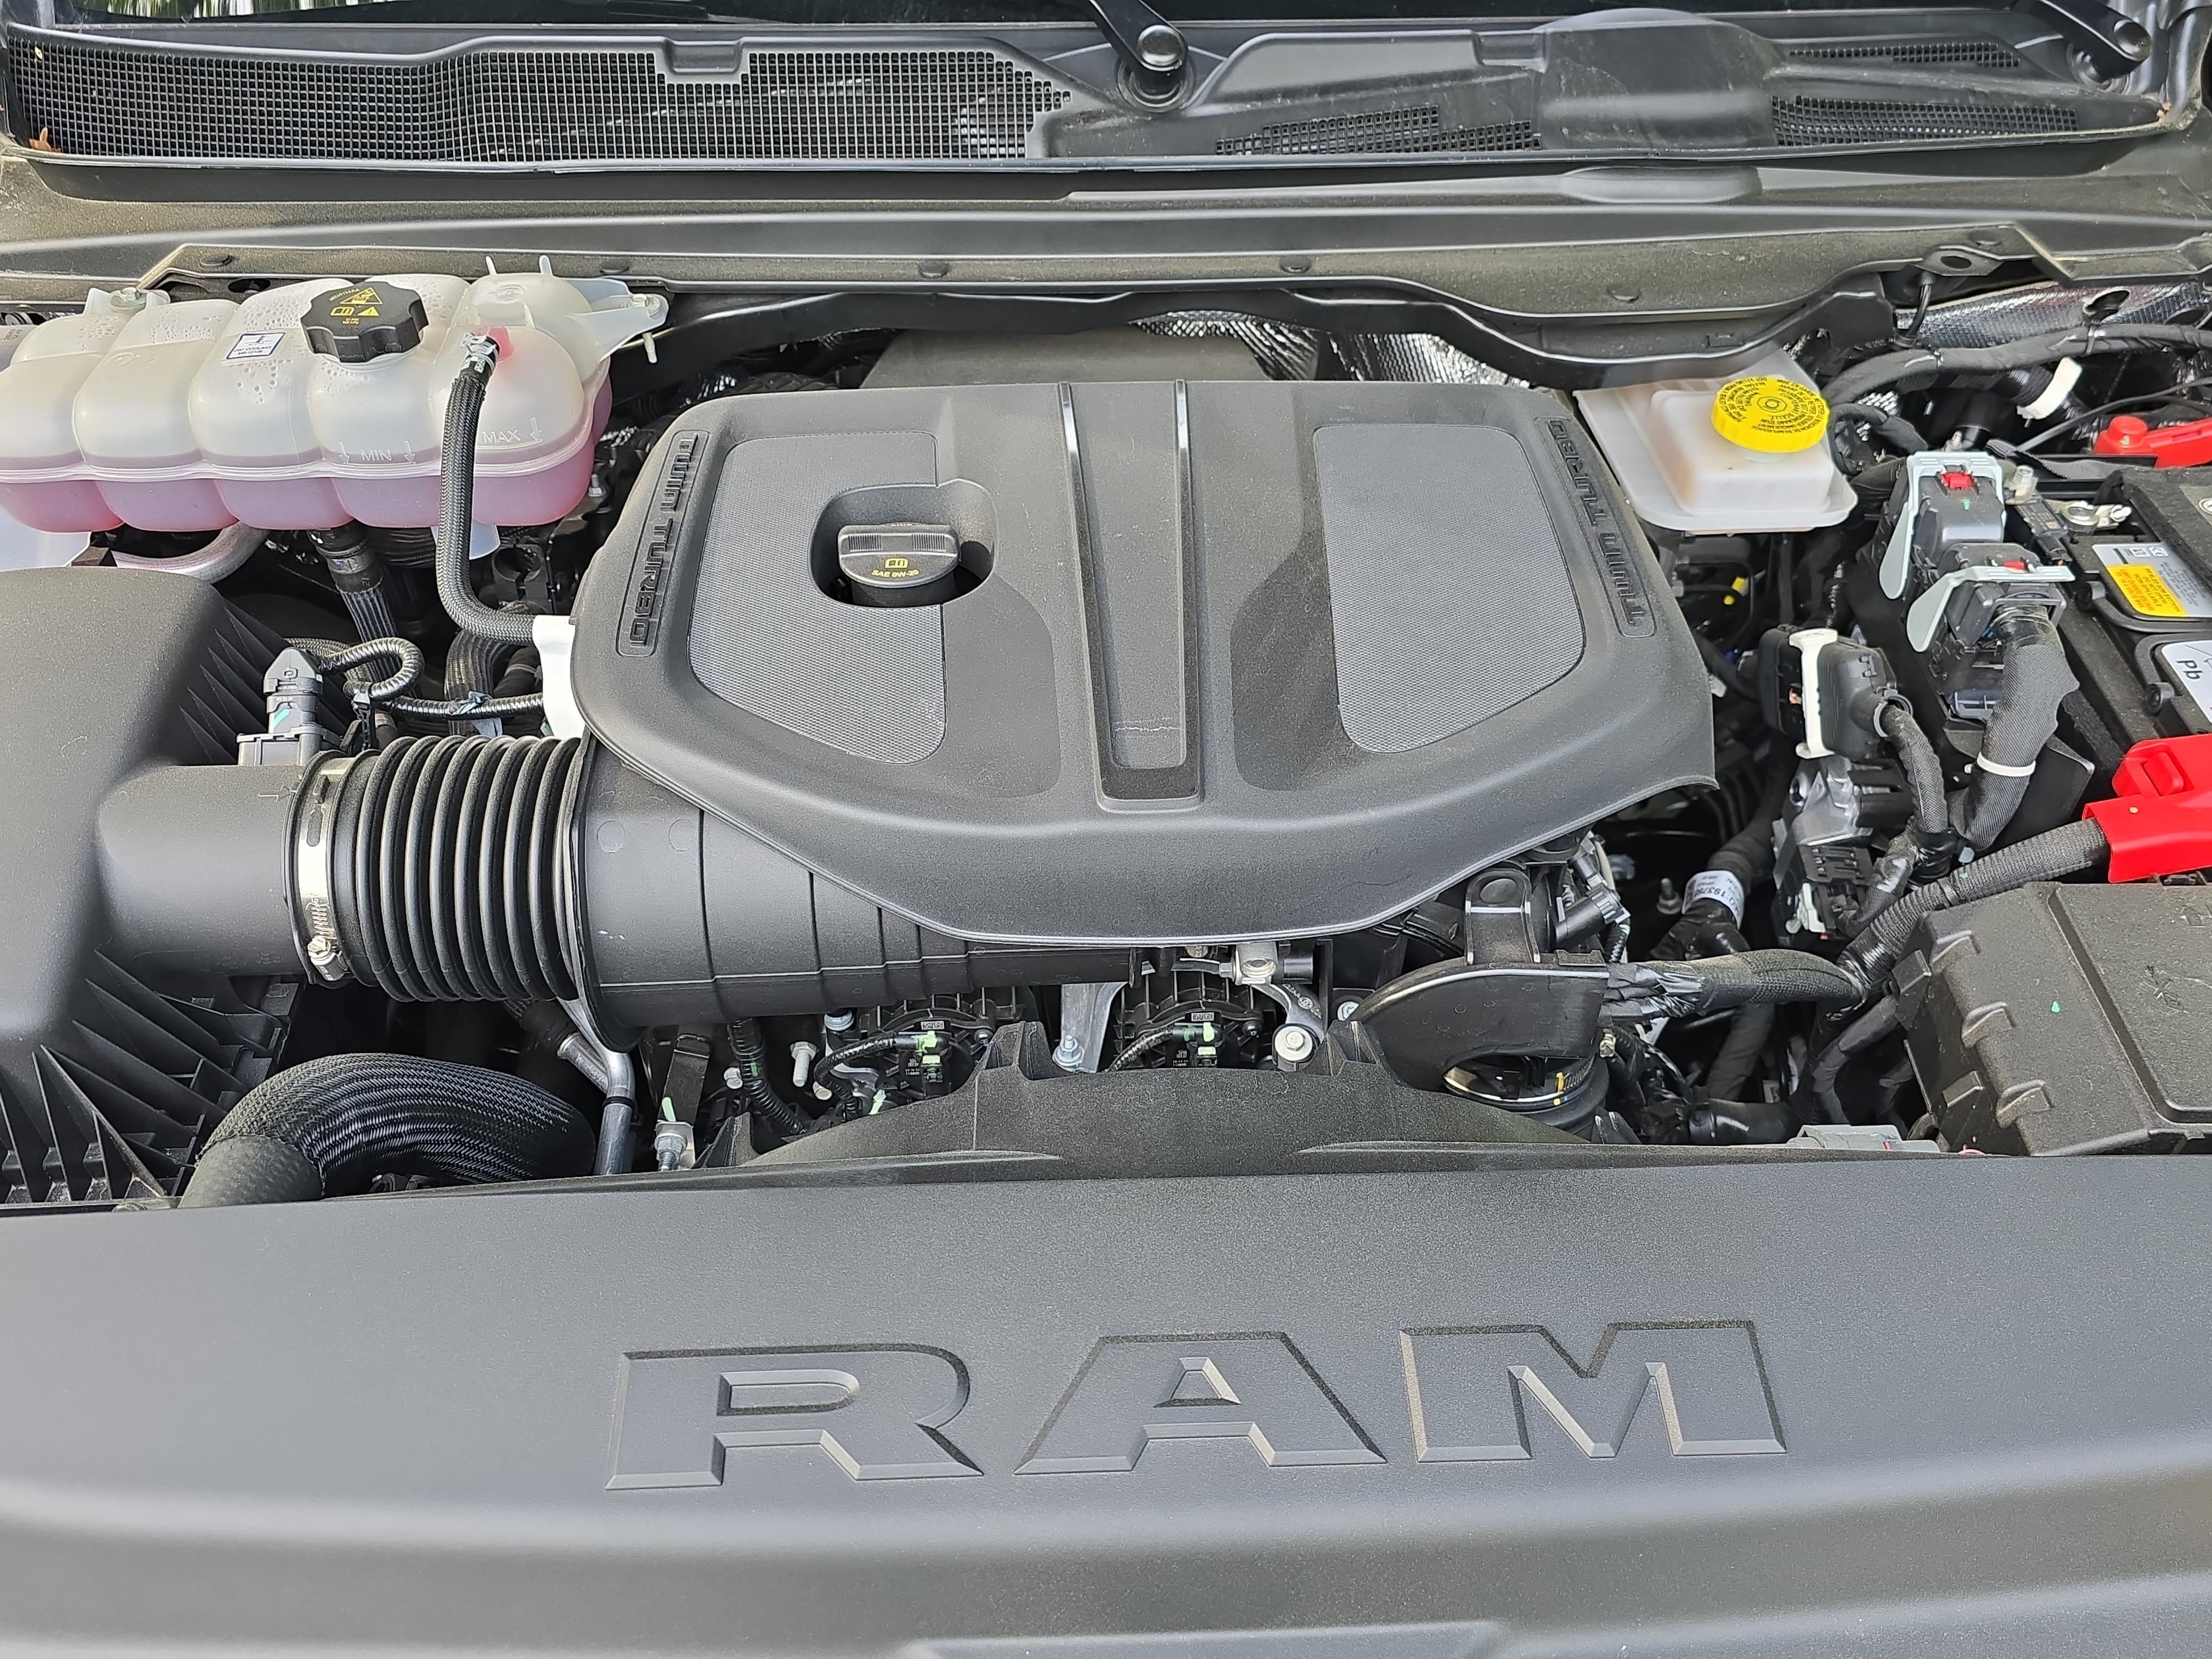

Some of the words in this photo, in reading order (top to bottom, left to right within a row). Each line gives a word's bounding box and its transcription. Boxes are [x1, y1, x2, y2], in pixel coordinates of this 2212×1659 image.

[361, 449, 392, 462] MIN
[481, 429, 522, 443] MAX
[659, 433, 699, 513] TWIN
[1547, 419, 1606, 527] TURBO
[629, 517, 674, 648] TURBO
[871, 569, 890, 577] SAE
[892, 569, 919, 577] 0W-20
[1598, 531, 1645, 626] TWIN
[2175, 660, 2203, 680] Pb
[605, 1318, 1788, 1491] RAM
